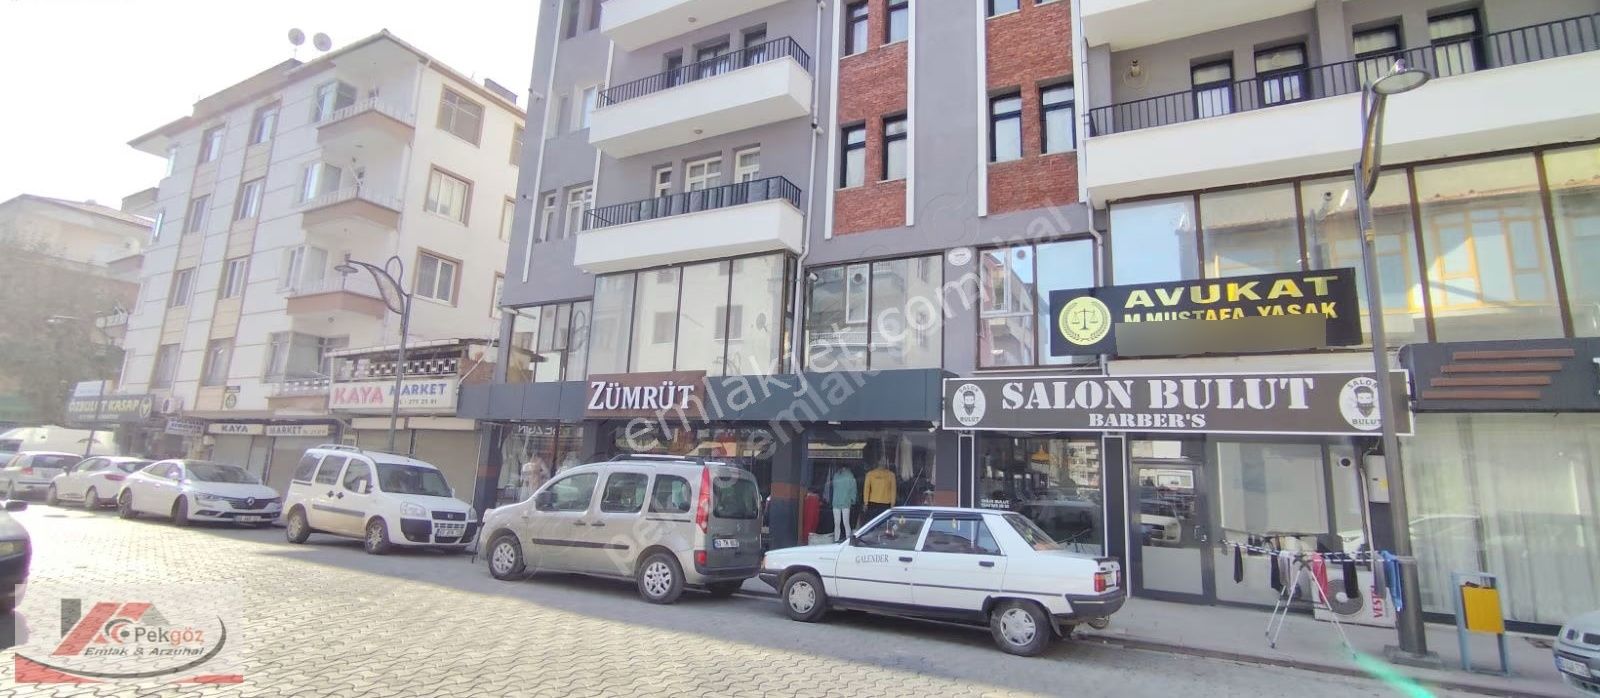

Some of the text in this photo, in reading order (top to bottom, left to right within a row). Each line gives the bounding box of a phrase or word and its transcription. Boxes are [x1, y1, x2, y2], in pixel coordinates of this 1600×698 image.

[1124, 275, 1339, 309] AVUKAT
[1124, 307, 1244, 323] MMUSTAFA
[1347, 379, 1379, 390] SALON
[335, 386, 384, 405] KAYA
[588, 380, 695, 410] ZÜMRÜT
[1001, 377, 1315, 411] SALON BULUT
[221, 424, 248, 433] KAYA
[270, 425, 302, 435] MARKET
[1089, 412, 1206, 430] BARBER'S
[1352, 418, 1383, 426] BULUT
